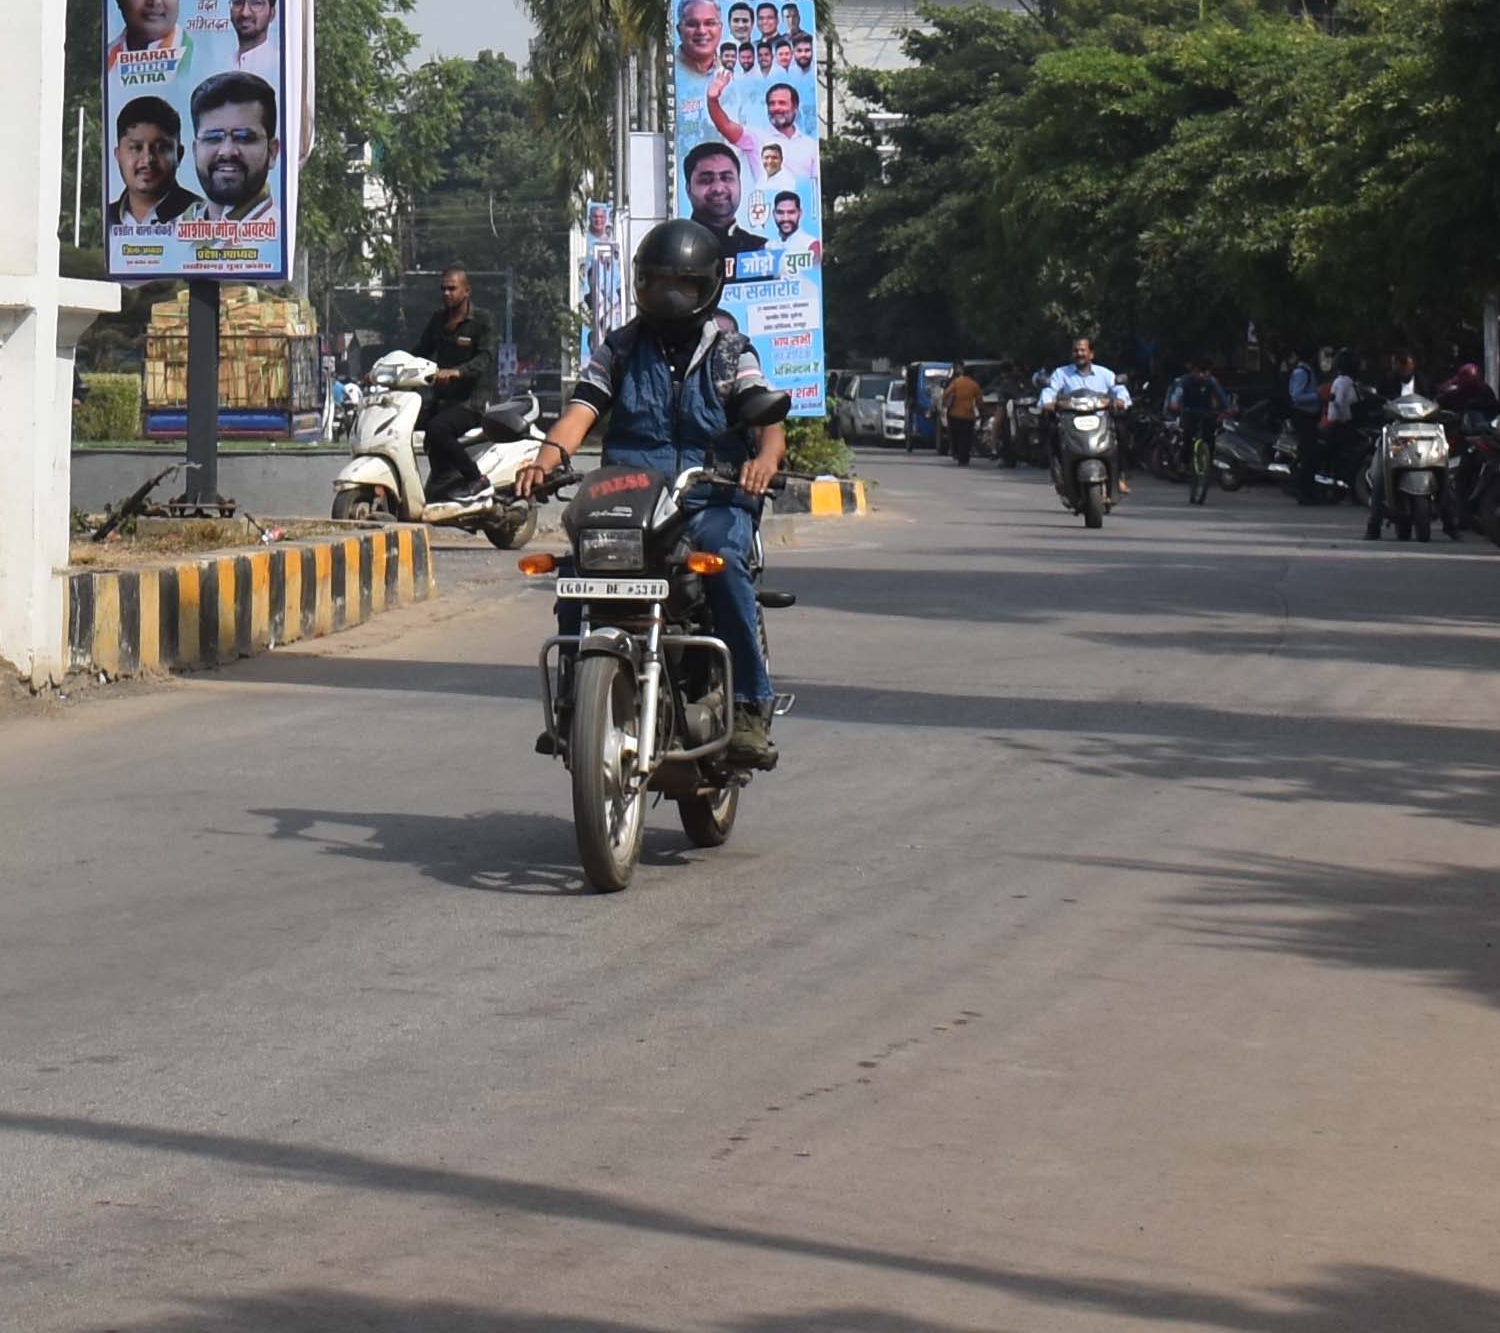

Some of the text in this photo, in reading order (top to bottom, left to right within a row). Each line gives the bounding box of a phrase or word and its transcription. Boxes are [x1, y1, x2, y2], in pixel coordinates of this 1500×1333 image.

[120, 48, 176, 64] BHARAT
[121, 72, 166, 85] YATRA
[741, 252, 775, 277] जोड़ो
[785, 253, 812, 274] युवा
[745, 278, 801, 300] समारोह
[590, 472, 651, 499] PRESS
